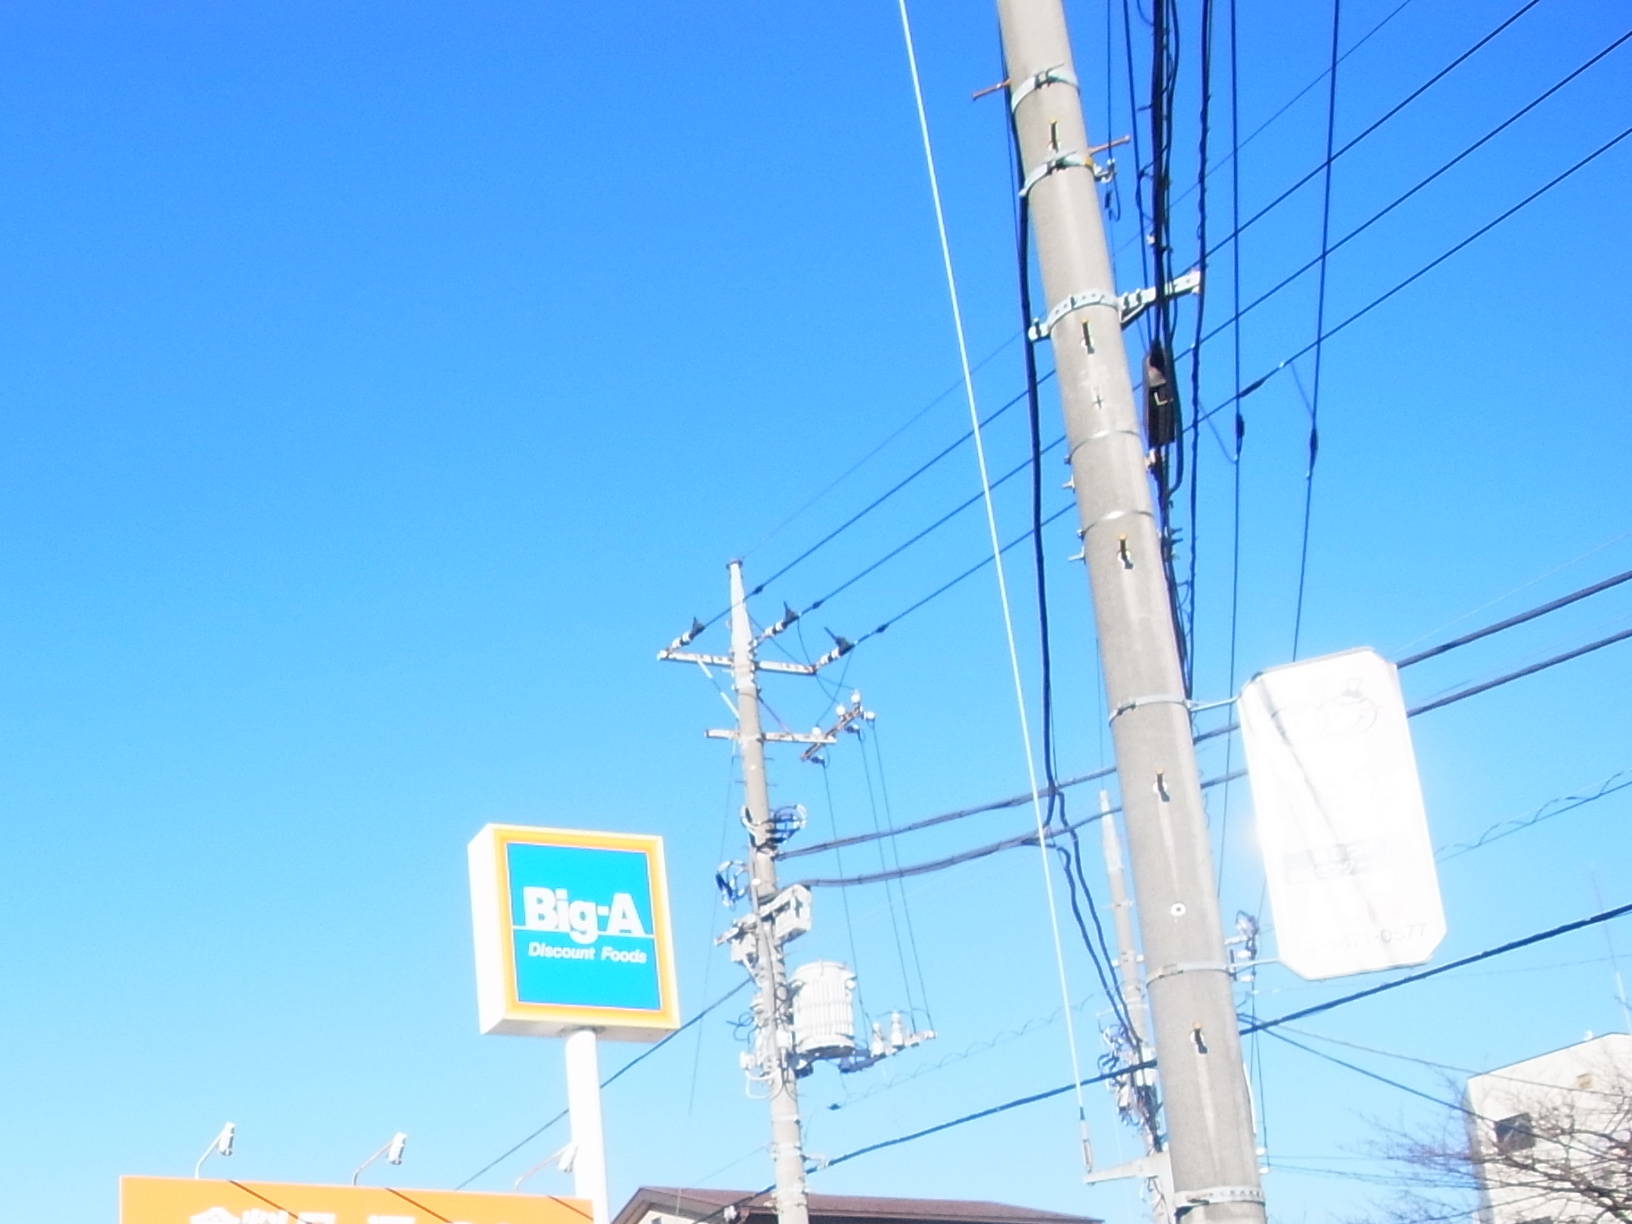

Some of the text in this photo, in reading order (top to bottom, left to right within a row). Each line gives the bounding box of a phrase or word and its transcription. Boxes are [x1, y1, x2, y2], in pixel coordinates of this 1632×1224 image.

[523, 886, 645, 944] Big-A
[528, 942, 647, 963] Discount Foods
